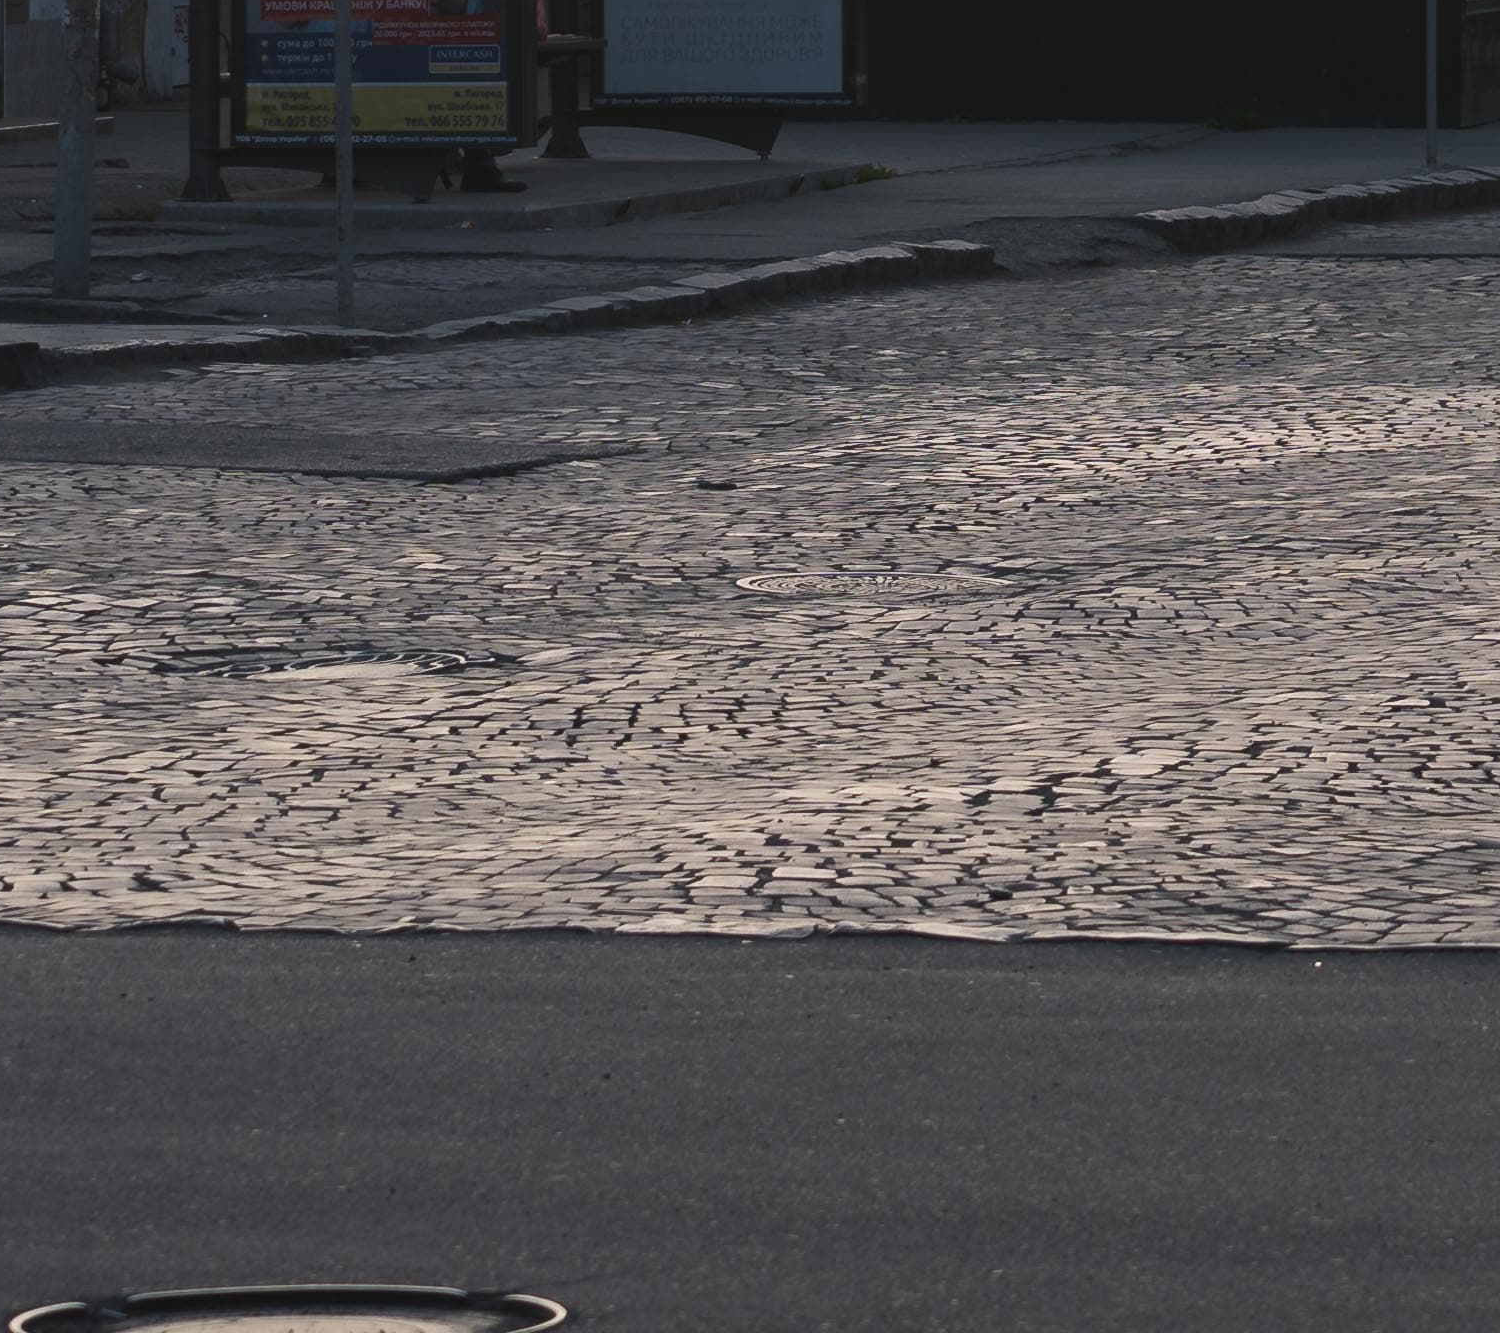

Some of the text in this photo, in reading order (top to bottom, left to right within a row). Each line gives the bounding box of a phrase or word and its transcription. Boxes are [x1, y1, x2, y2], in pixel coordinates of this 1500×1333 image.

[264, 0, 307, 12] УМОВИ
[352, 0, 373, 11] НІЖ
[277, 40, 300, 49] сума
[302, 40, 315, 49] до
[277, 53, 310, 63] термін
[312, 55, 325, 63] до
[436, 50, 495, 59] INTERCASH
[452, 115, 472, 126] 555
[475, 115, 488, 126] 79
[492, 115, 505, 126] 76
